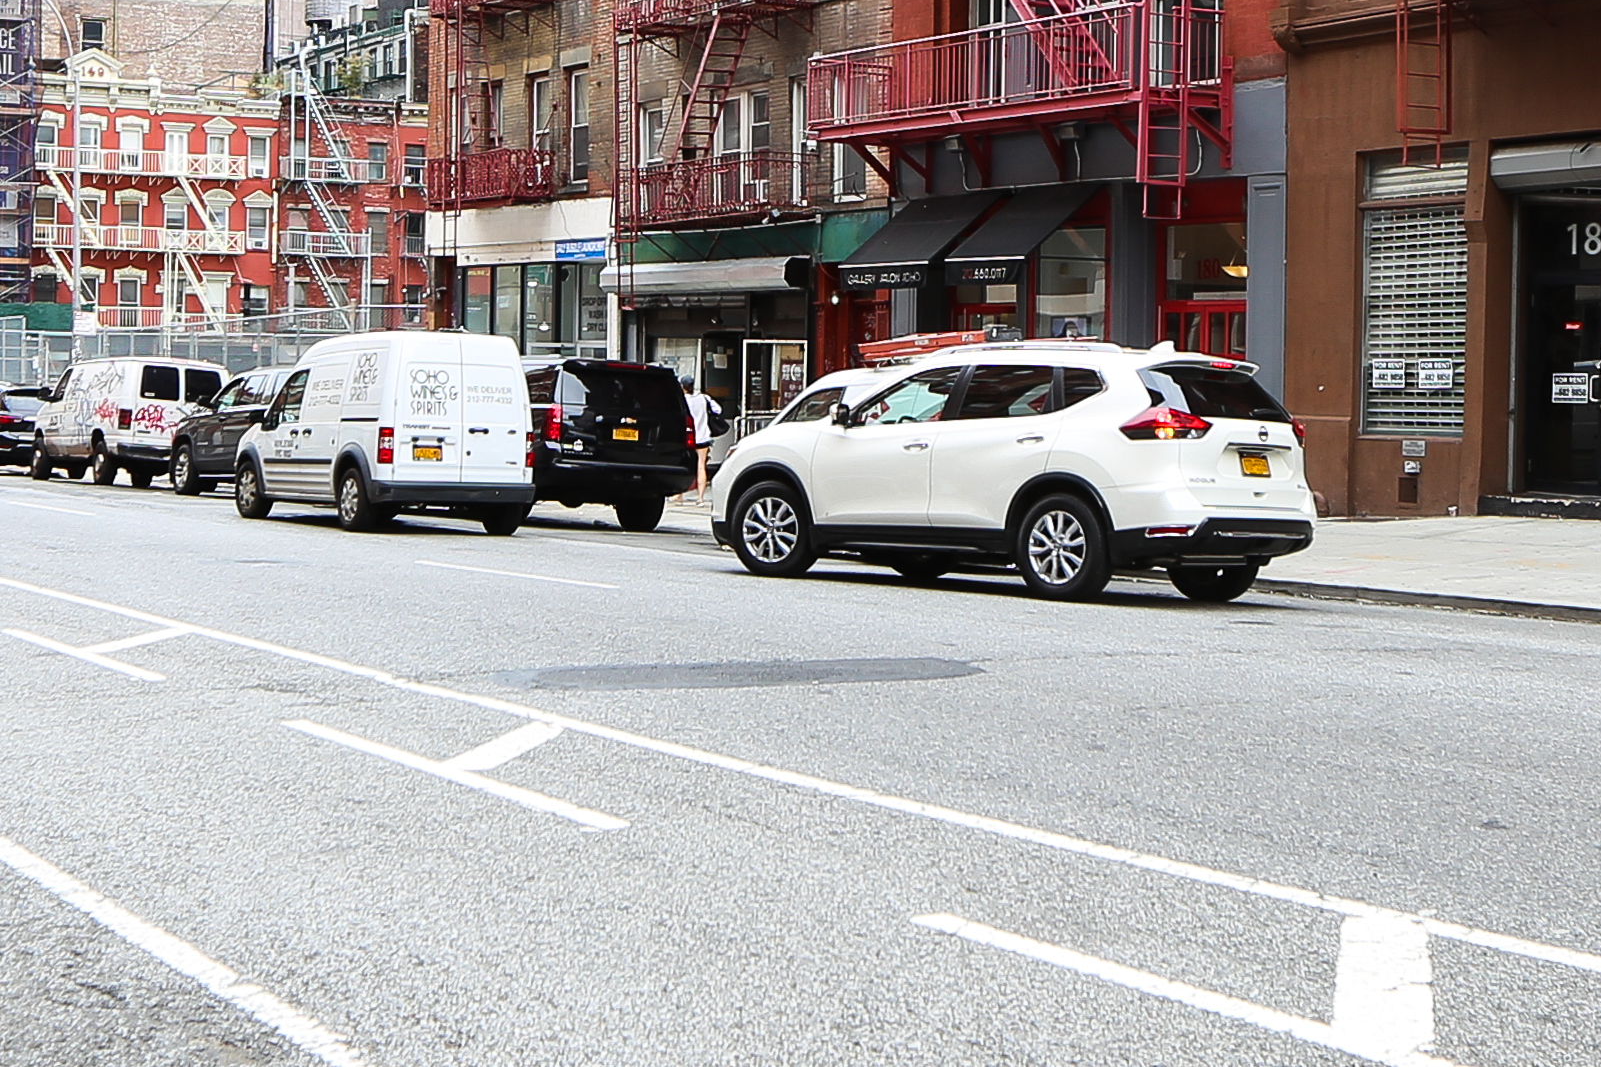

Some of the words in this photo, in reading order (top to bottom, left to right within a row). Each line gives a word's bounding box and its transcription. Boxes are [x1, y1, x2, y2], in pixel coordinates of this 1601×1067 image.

[1196, 258, 1220, 280] 180
[410, 369, 449, 385] SOHO
[1555, 376, 1568, 384] FOR
[1569, 376, 1586, 384] RENT
[410, 385, 447, 400] WINES
[449, 386, 458, 400] &
[481, 386, 512, 394] DELIVER
[410, 400, 447, 416] SPIRITS
